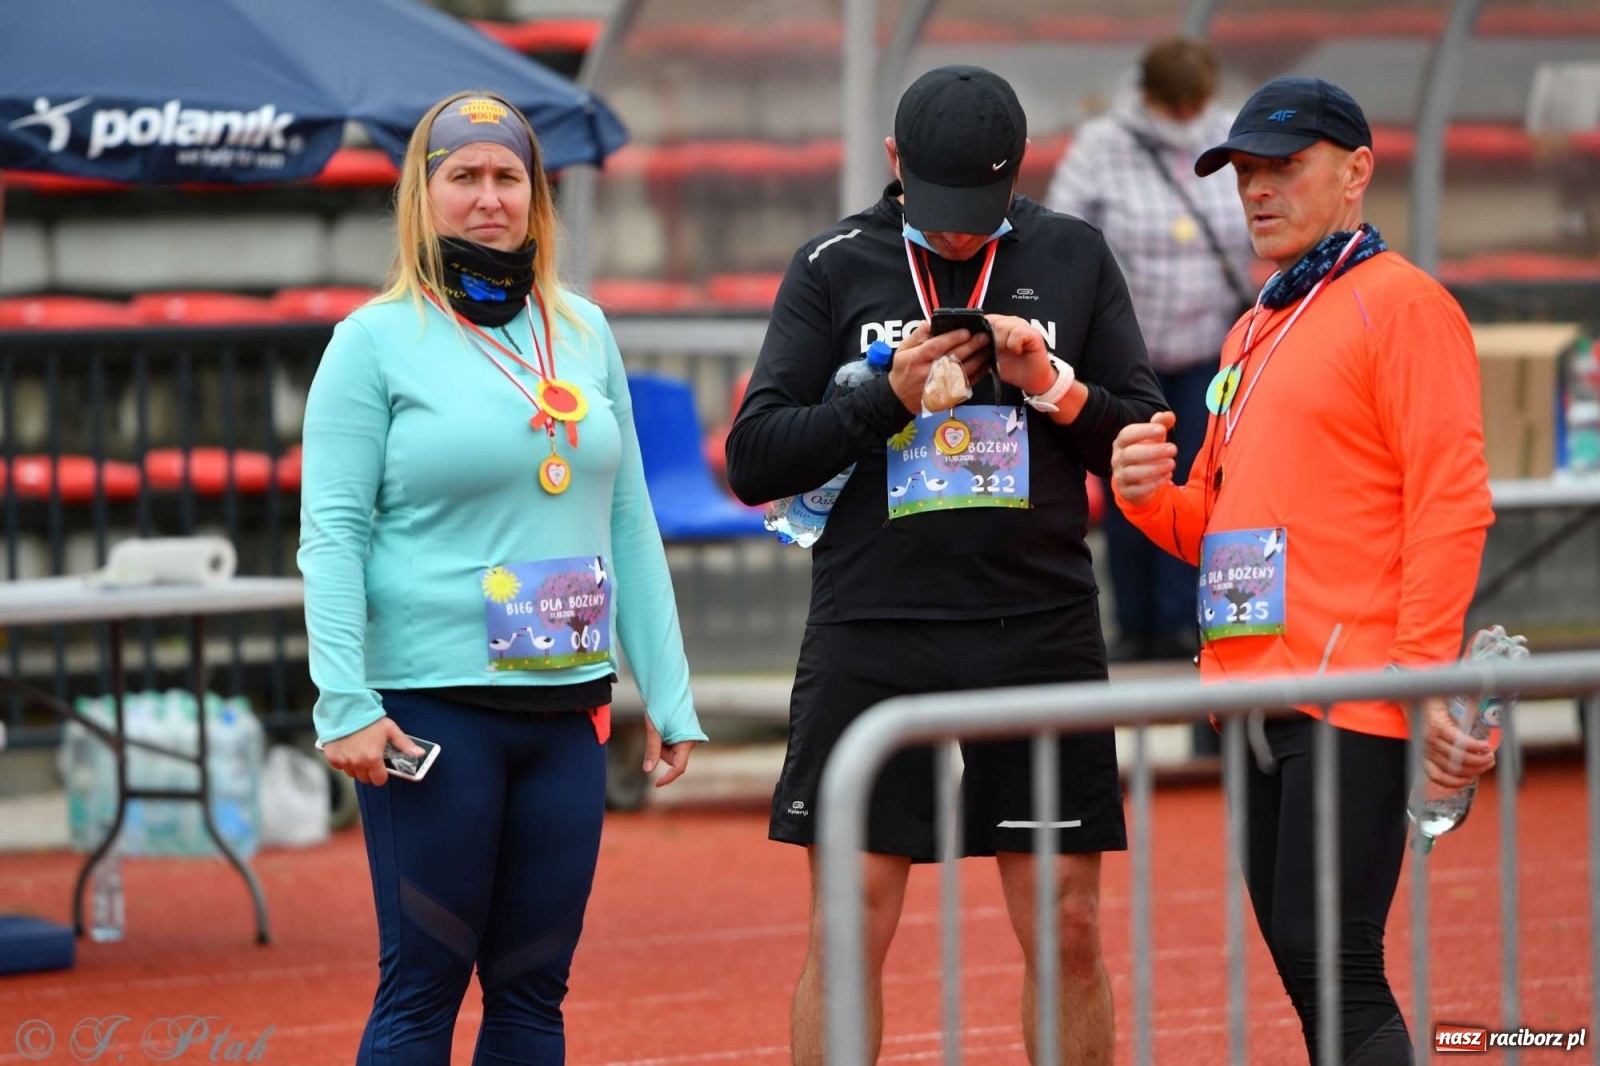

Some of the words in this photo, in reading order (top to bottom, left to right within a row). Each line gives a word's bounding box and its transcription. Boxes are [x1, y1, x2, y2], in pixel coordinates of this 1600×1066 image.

[88, 99, 296, 159] polanik
[903, 446, 928, 462] BIEG
[971, 474, 1015, 493] 222
[506, 601, 533, 616] BIEG
[540, 598, 563, 612] DLA
[1226, 601, 1269, 622] 225
[570, 625, 601, 652] 069
